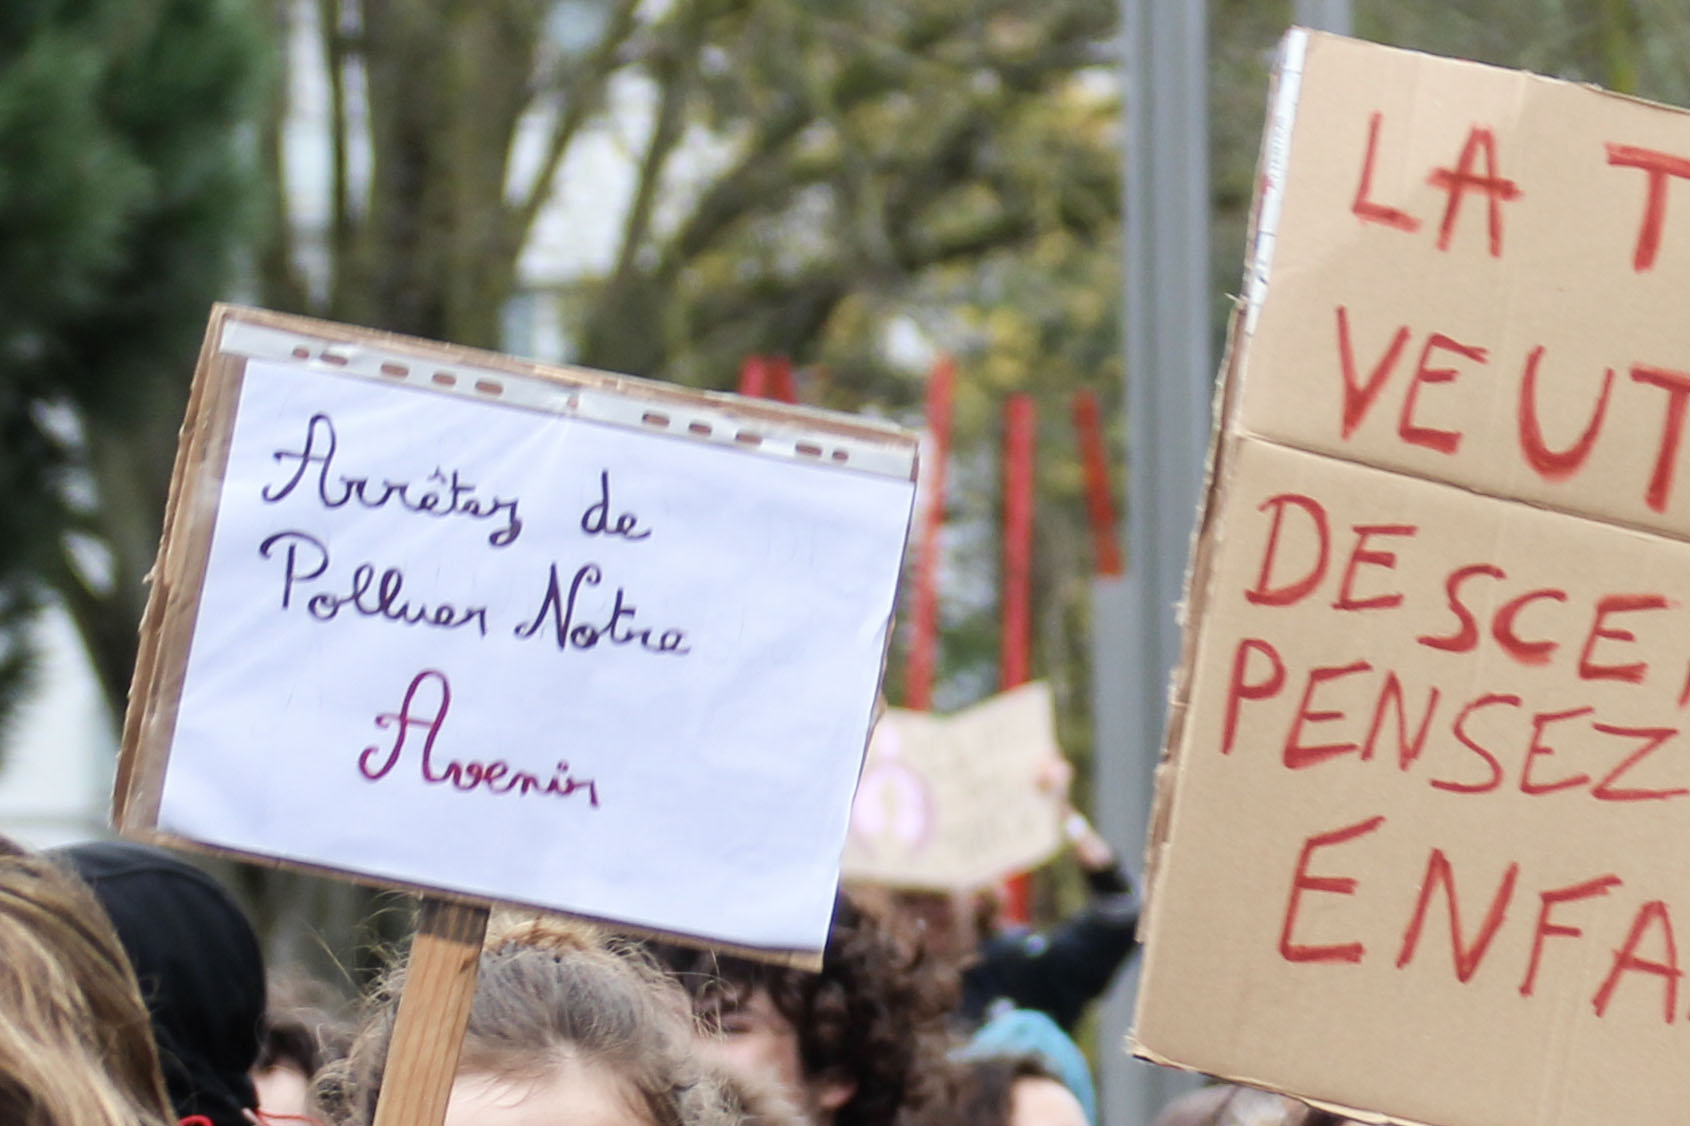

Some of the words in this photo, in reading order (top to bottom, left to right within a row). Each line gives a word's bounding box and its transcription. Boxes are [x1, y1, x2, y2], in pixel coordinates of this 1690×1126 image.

[1351, 112, 1522, 258] LA
[260, 413, 523, 548] Arrêtez
[580, 470, 652, 540] de
[258, 530, 487, 637] Polluer
[513, 562, 691, 653] Notre
[358, 669, 599, 808] Avenir
